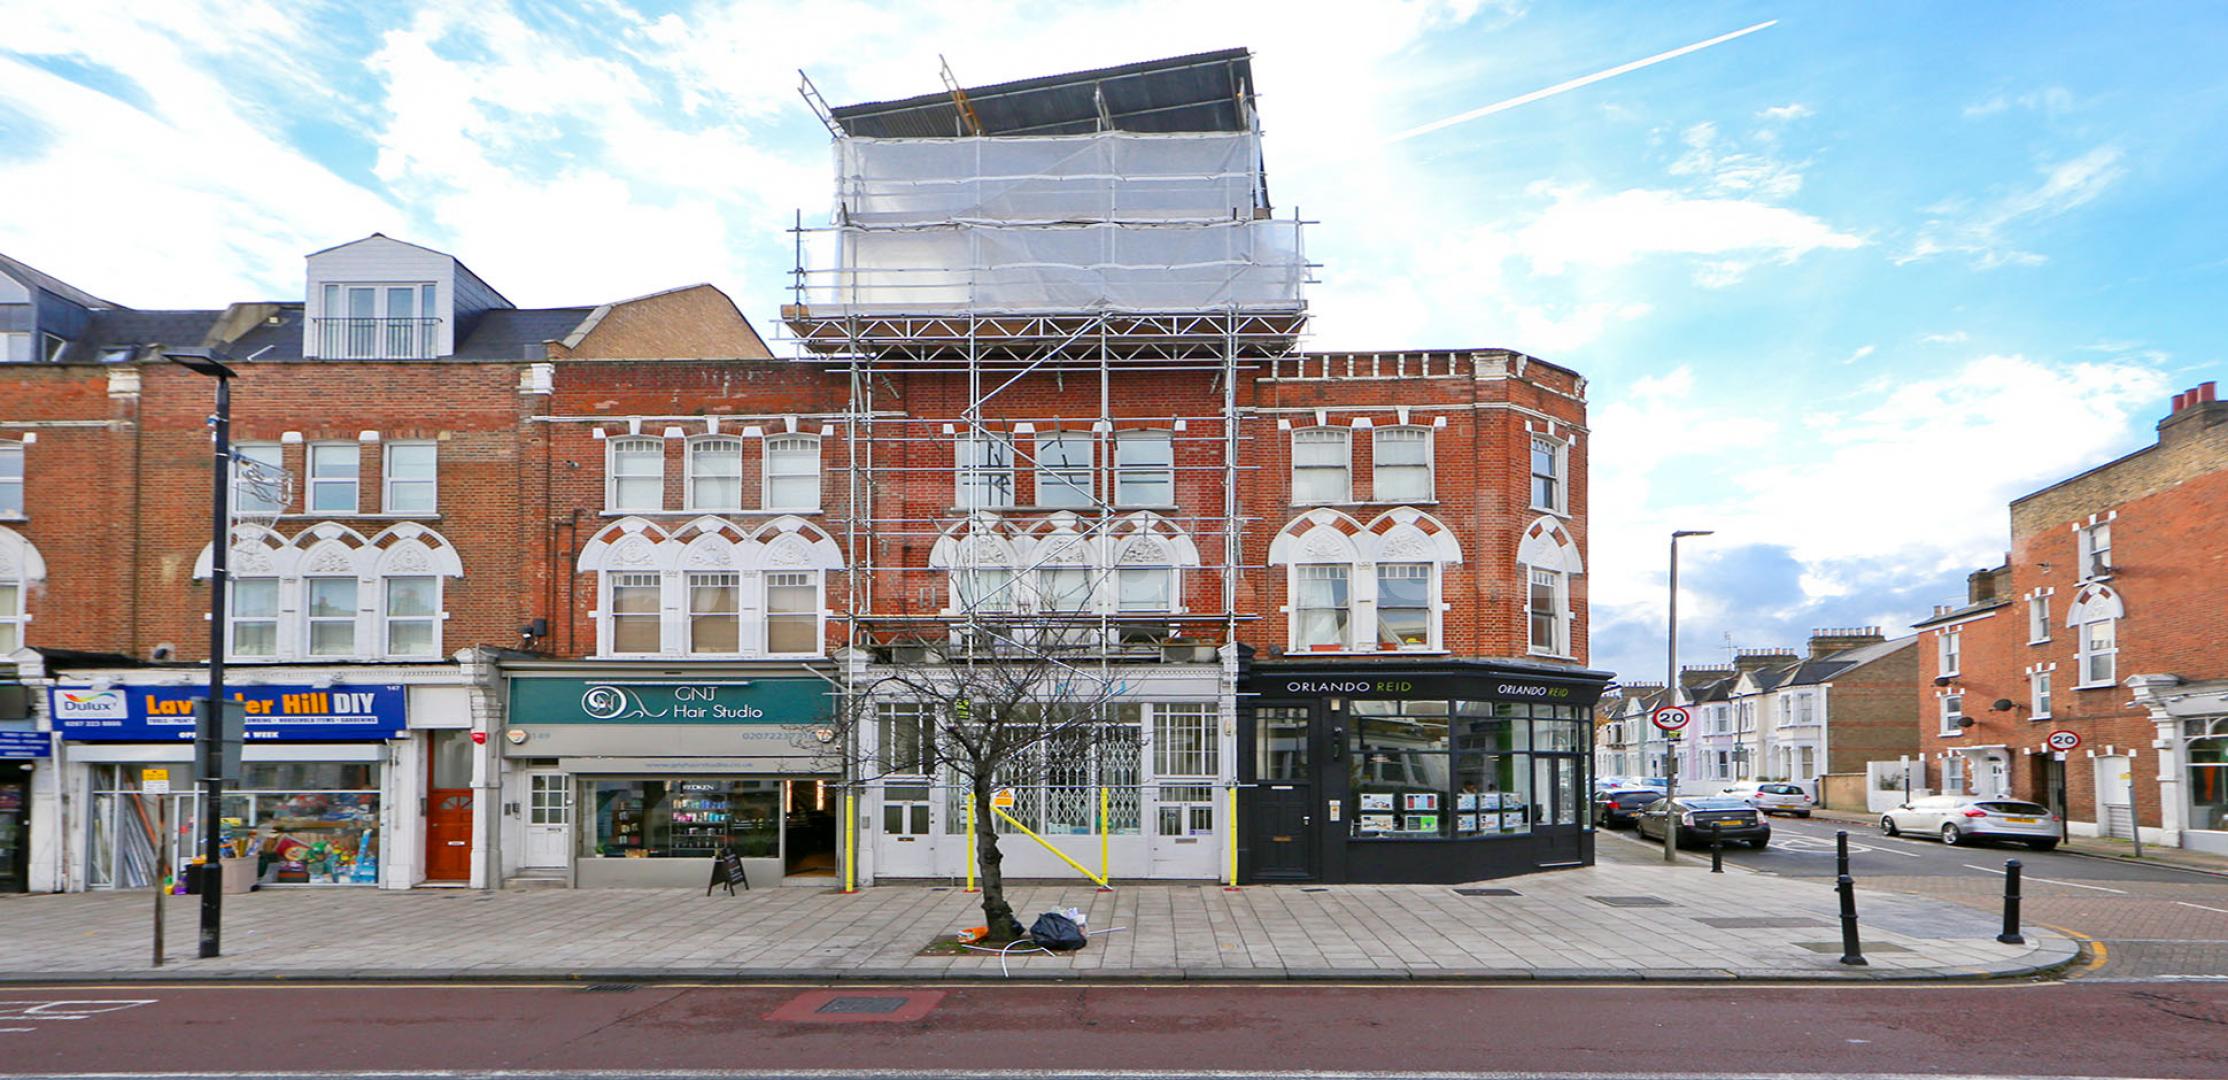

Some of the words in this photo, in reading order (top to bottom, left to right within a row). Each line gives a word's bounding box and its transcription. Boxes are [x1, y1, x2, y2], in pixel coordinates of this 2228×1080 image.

[1287, 681, 1370, 693] ORLANDO
[1376, 681, 1412, 693] REID
[1498, 684, 1547, 697] ORLANDO
[1548, 686, 1568, 698] REID
[674, 687, 719, 701] GNJ
[64, 701, 111, 711] Dulux
[146, 693, 275, 715] Laver
[282, 692, 329, 715] Hill
[333, 693, 375, 715] DIY
[674, 704, 708, 718] Hair
[713, 704, 764, 718] Studio
[1659, 712, 1685, 723] 20
[2053, 736, 2076, 744] 20
